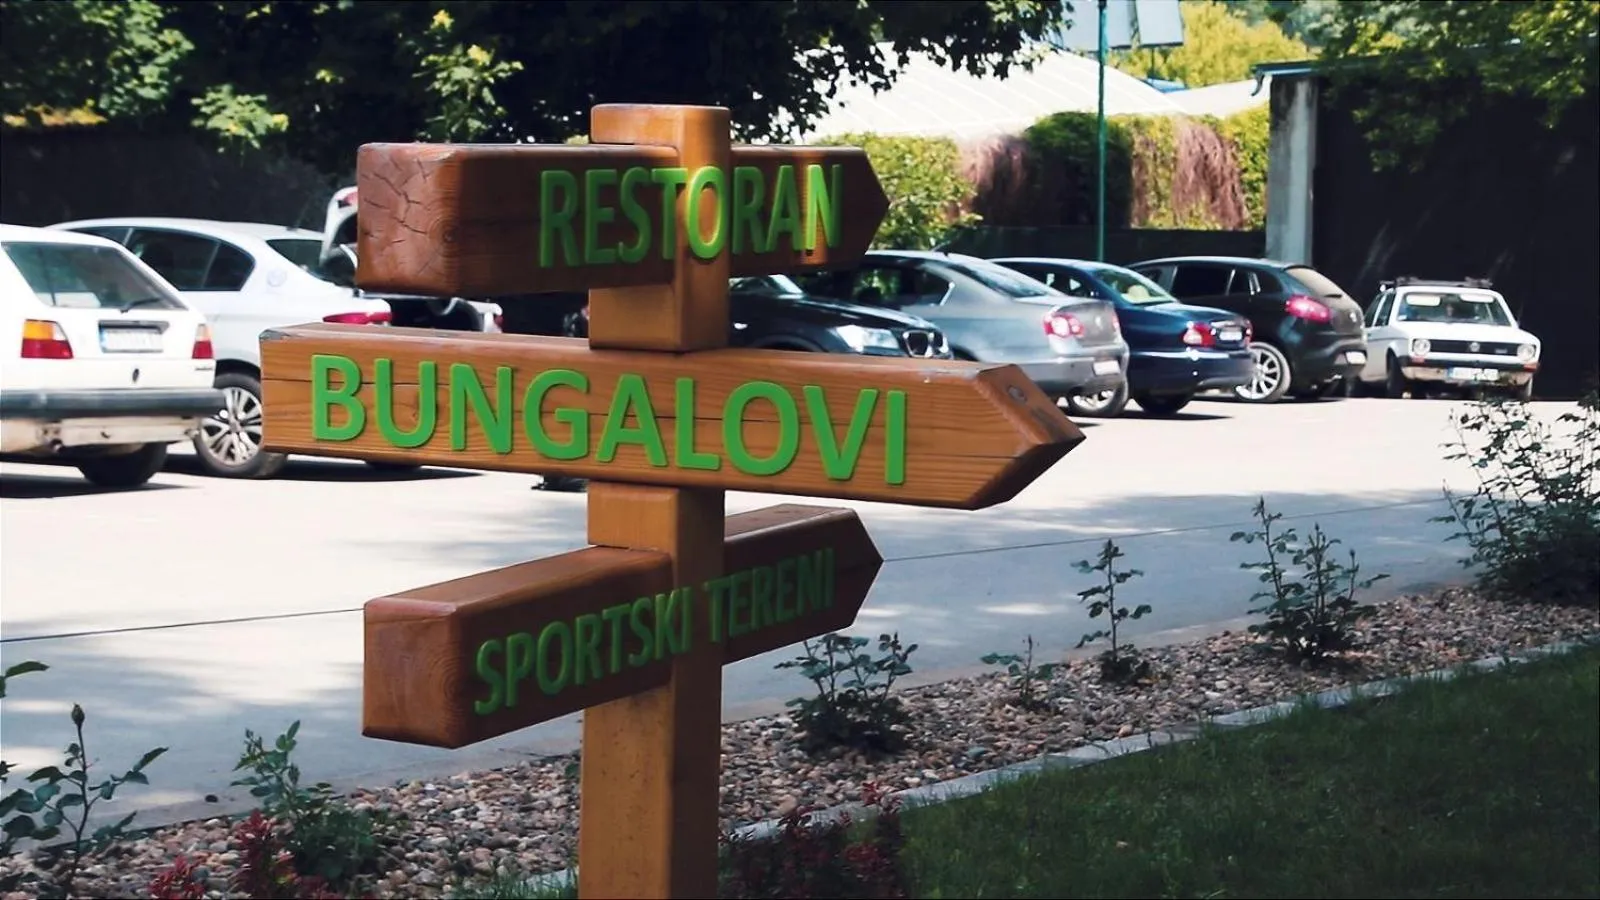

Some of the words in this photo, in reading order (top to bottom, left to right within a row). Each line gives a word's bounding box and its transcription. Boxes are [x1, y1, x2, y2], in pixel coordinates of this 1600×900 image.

[540, 164, 842, 268] RESTORAN
[311, 354, 907, 484] BUNGALOVI
[474, 587, 693, 715] SPORTSKI
[704, 547, 835, 644] TERENI
